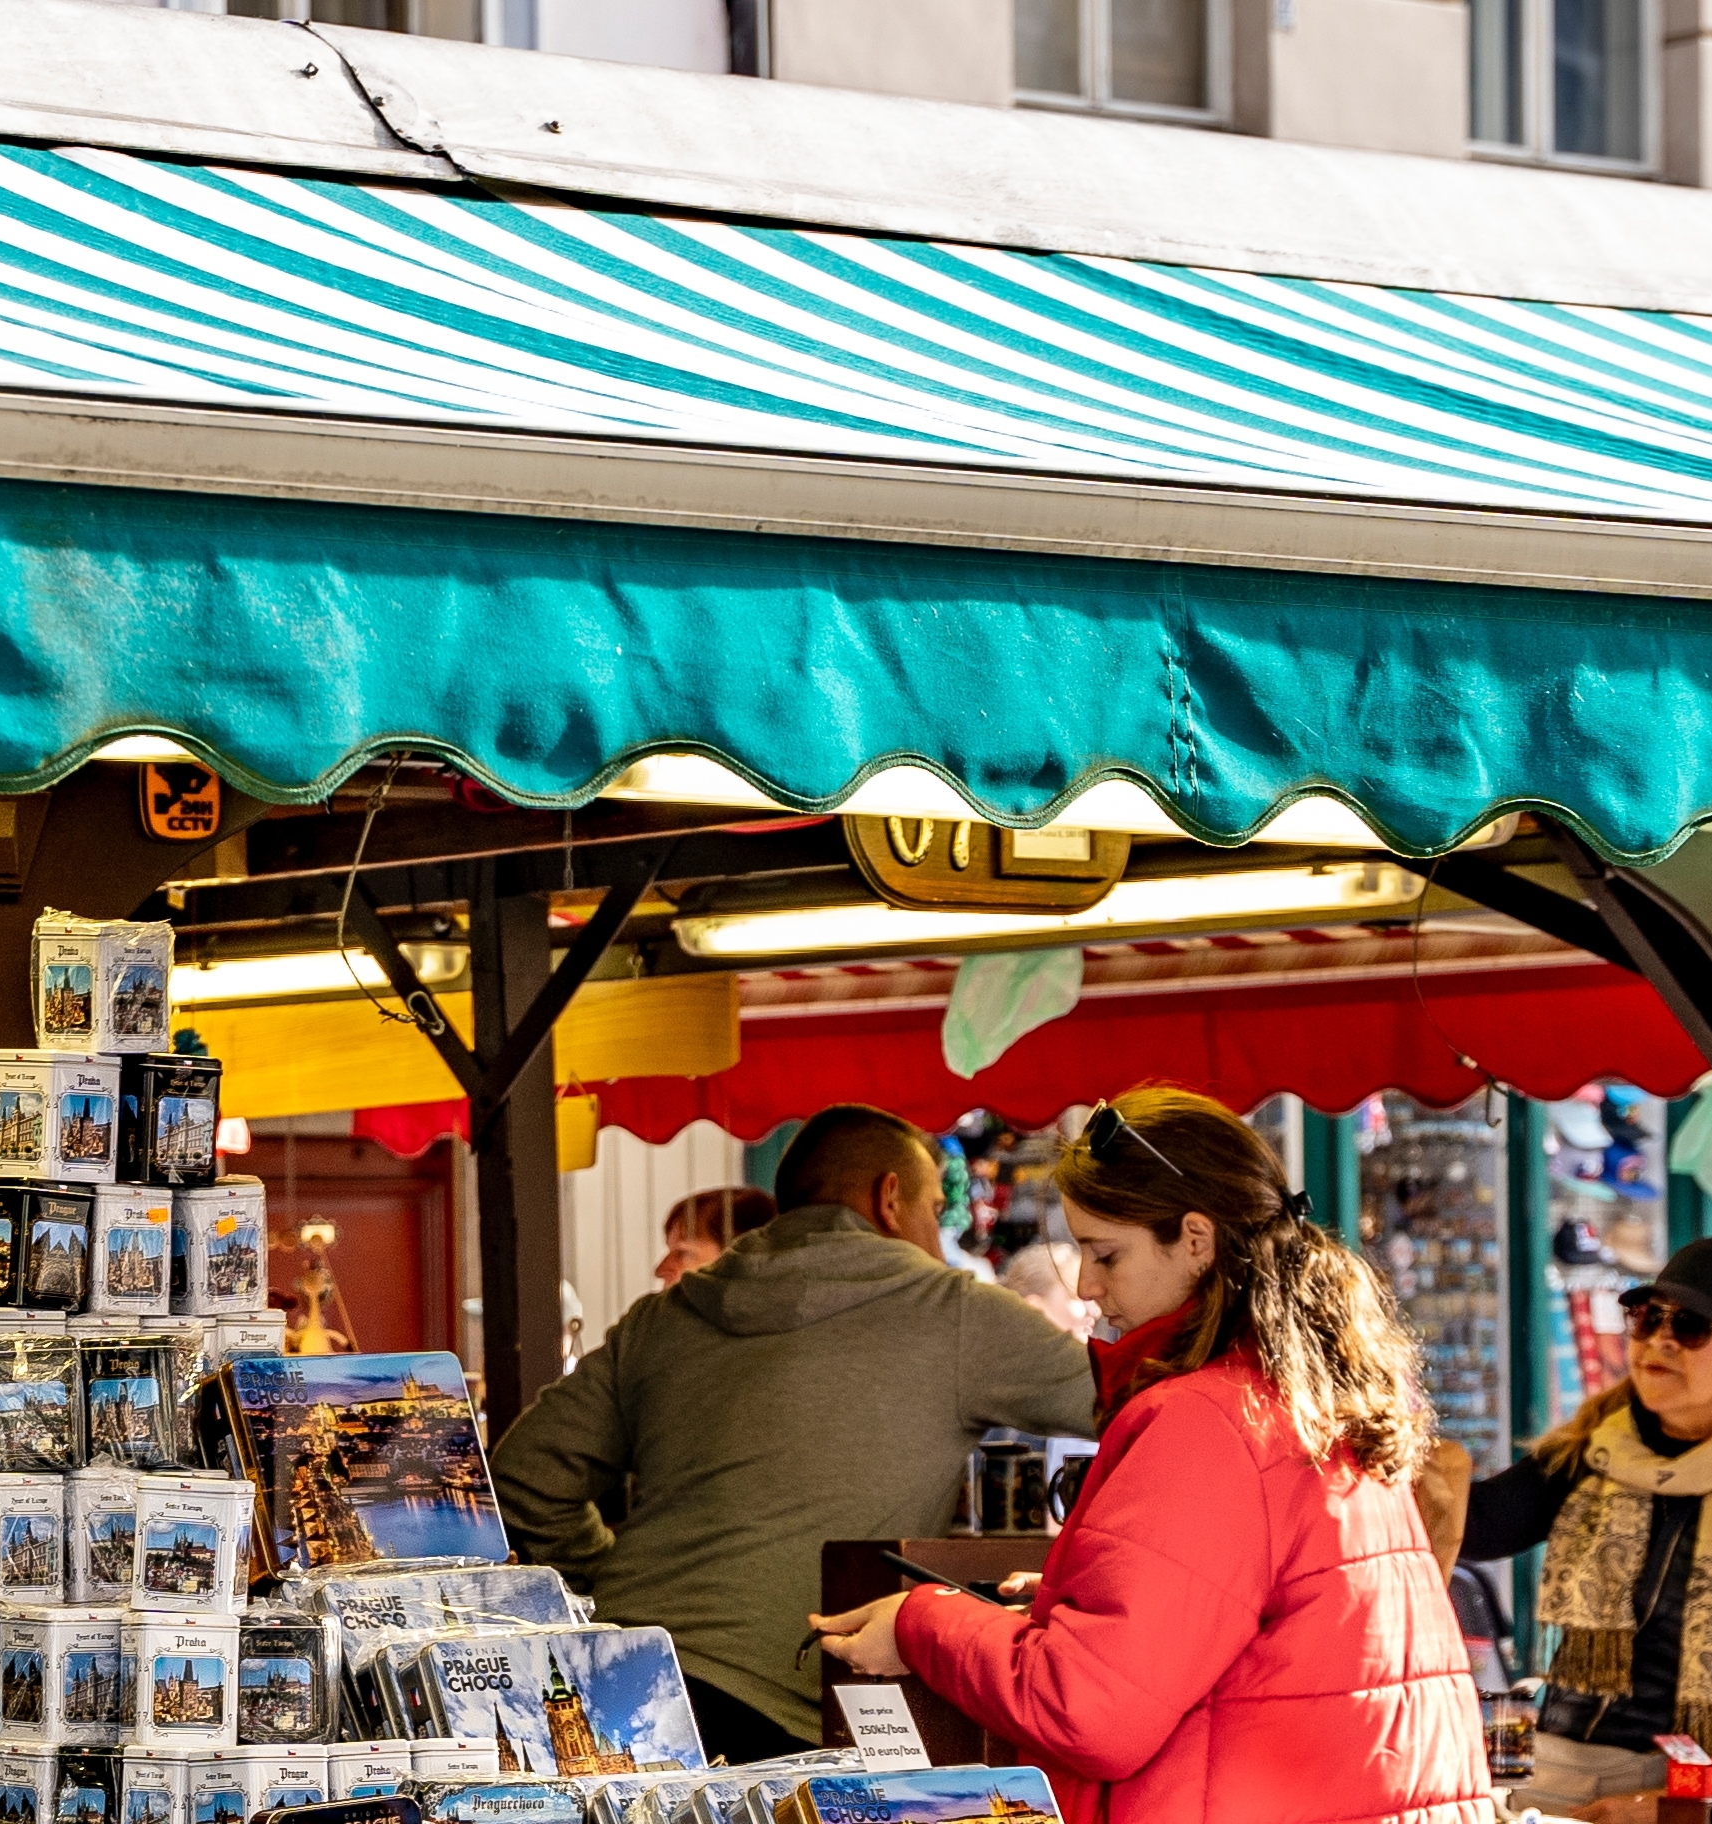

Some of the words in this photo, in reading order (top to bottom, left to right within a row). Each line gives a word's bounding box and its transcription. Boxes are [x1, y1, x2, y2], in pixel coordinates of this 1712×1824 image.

[168, 817, 214, 831] CCTV
[48, 1201, 77, 1216] Prague
[241, 1371, 307, 1389] PRAGUE
[244, 1388, 308, 1405] CHOCO
[337, 1595, 405, 1613] PRAGUE
[343, 1613, 407, 1631] CHOCO
[174, 1635, 207, 1649] Praha
[441, 1646, 507, 1658] ORIGINAL
[443, 1657, 512, 1675] PRAGUE
[448, 1674, 514, 1693] CHOCO
[858, 1707, 875, 1717] Best
[875, 1706, 894, 1717] price
[858, 1723, 910, 1737] 250kč/box
[862, 1746, 876, 1758] 10
[877, 1745, 923, 1758] euro/box
[279, 1766, 309, 1782] Prague
[819, 1787, 886, 1807] PRAGUE
[825, 1804, 892, 1824] CHOCO
